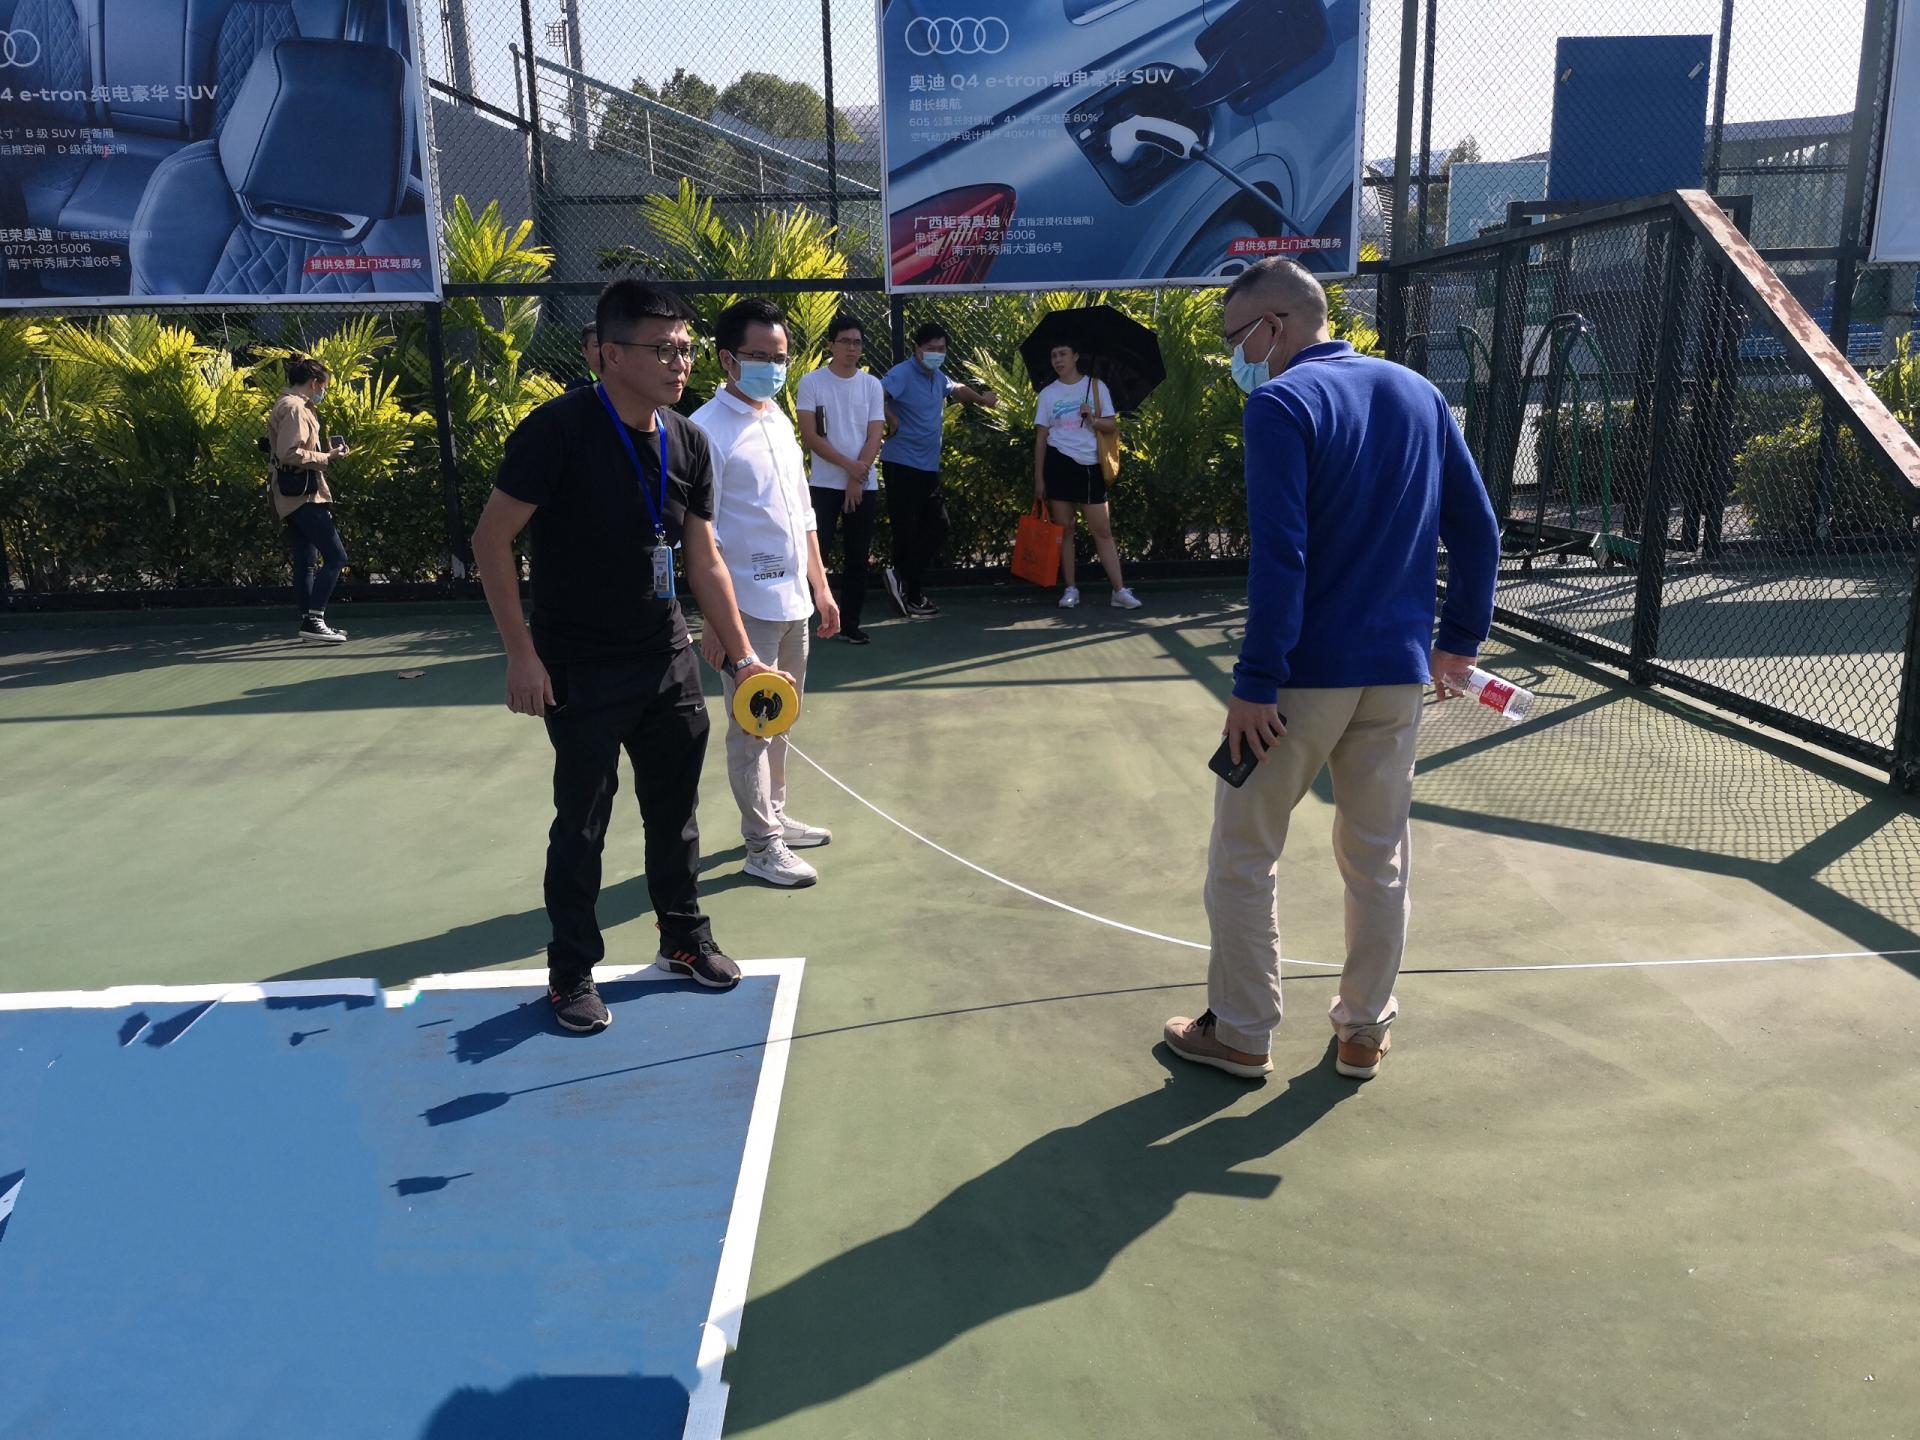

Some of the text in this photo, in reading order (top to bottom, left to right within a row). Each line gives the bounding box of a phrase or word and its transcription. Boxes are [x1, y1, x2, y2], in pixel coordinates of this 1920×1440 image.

[909, 69, 1175, 92] 奥迪 Q4 e-tron 纯电豪华 SUV
[19, 86, 87, 102] e-tron
[91, 84, 170, 103] 纯电豪华
[175, 85, 219, 100] SUV
[909, 98, 962, 112] 超长续航
[1073, 113, 1099, 123] 80%
[26, 129, 34, 138] B
[36, 128, 49, 139] 级
[51, 129, 76, 138] SUV
[4, 243, 92, 255] 0771-3215006
[1234, 238, 1342, 252] 提供免费上门试驾服务
[7, 255, 122, 270] 南宁市秀厢大道66号
[311, 258, 422, 270] 提供免费上门试驾服务
